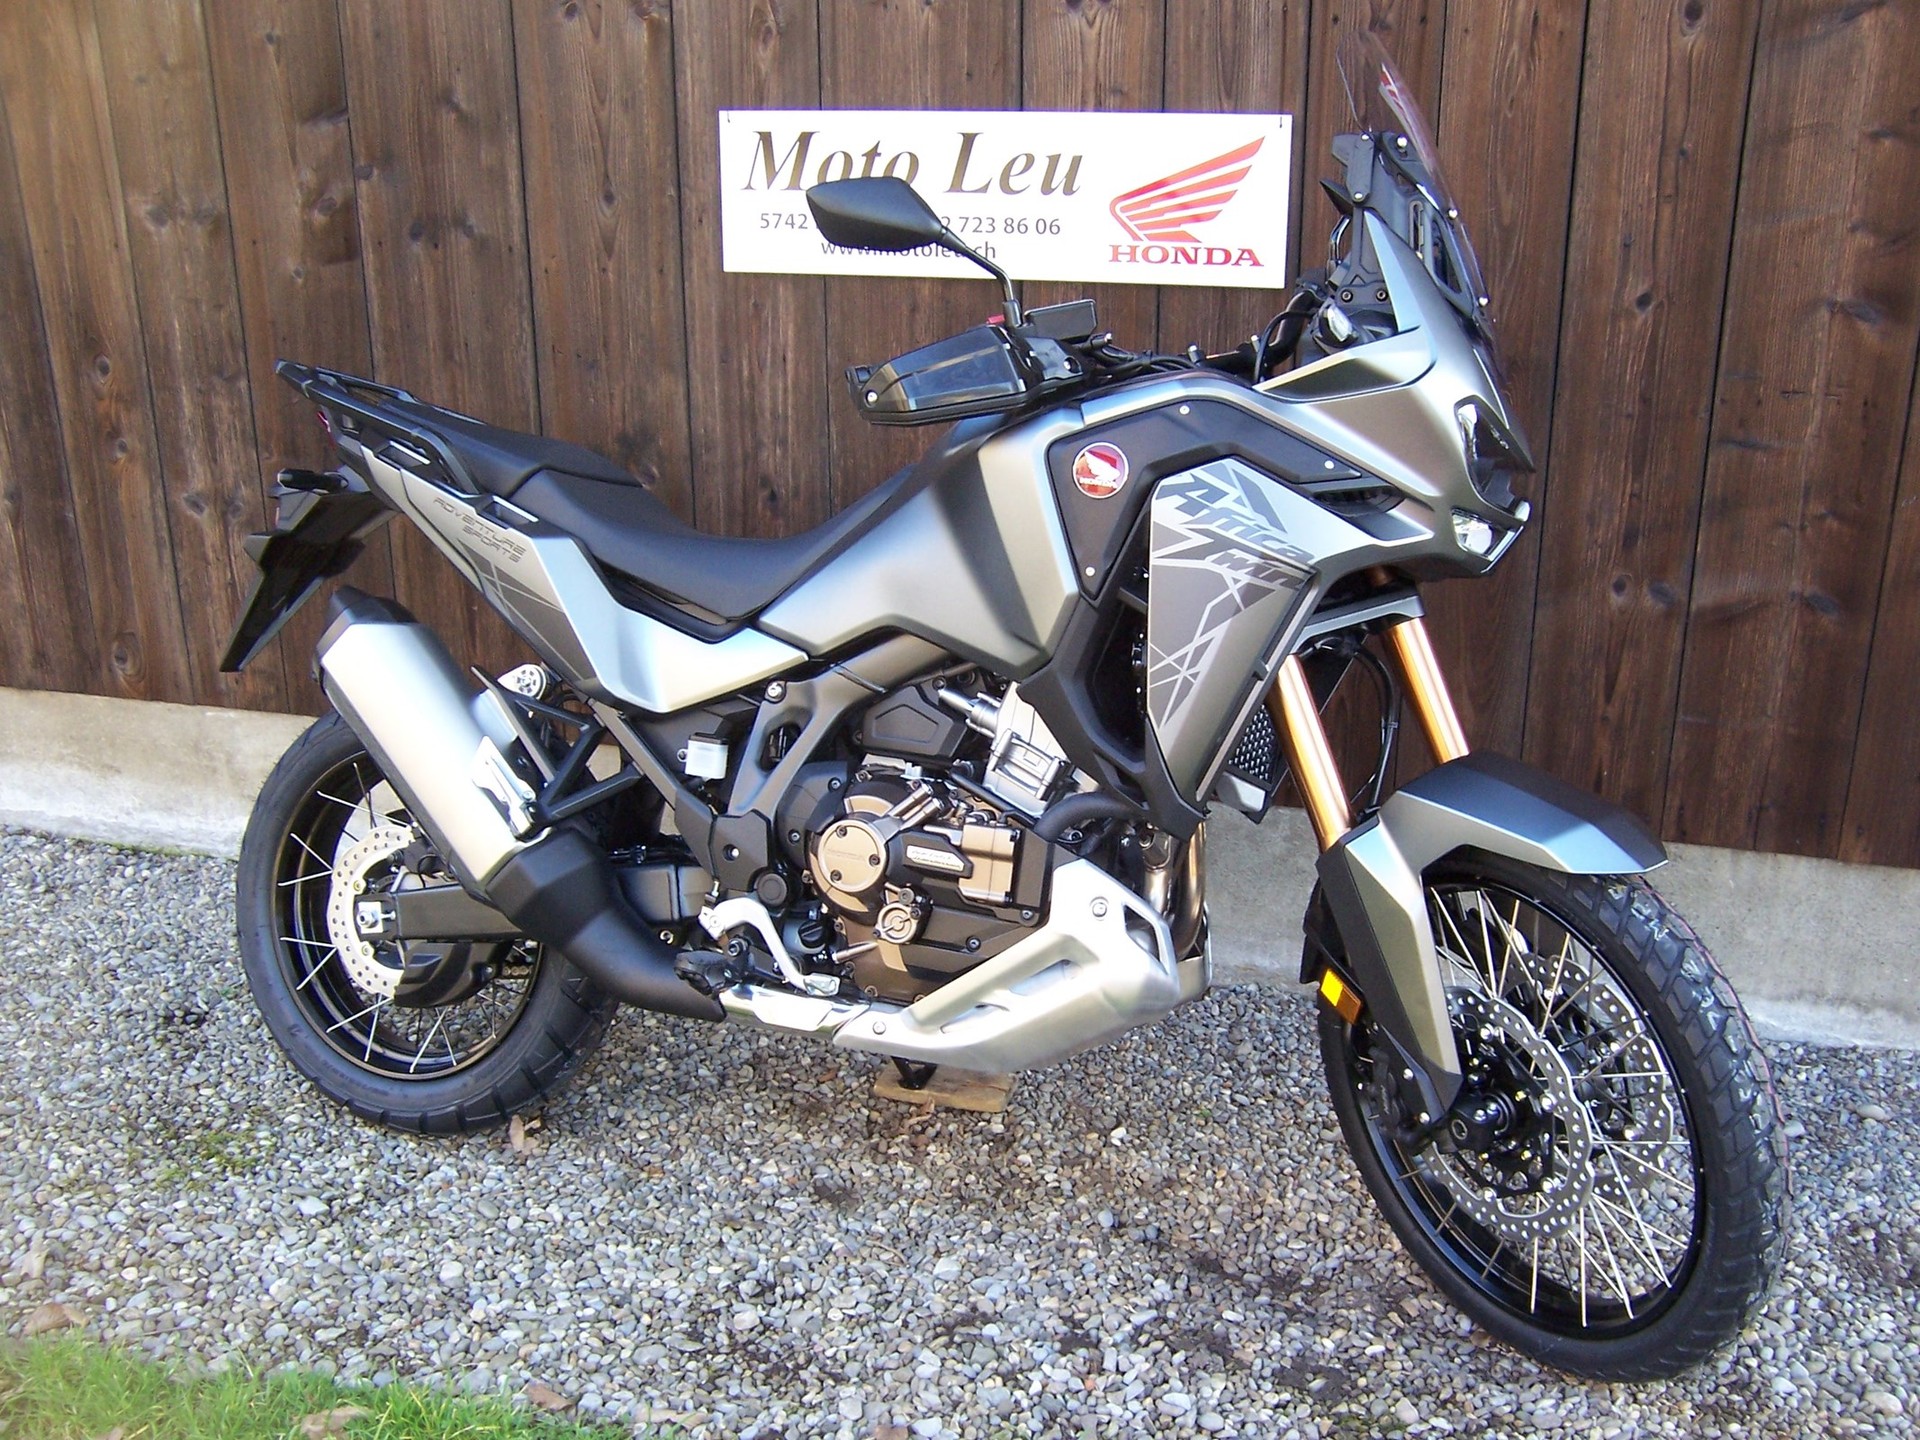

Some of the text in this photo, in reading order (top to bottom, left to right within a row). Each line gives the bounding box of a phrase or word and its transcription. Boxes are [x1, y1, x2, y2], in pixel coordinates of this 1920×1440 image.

[741, 131, 1083, 196] Moto Leu
[760, 213, 808, 230] 5742
[959, 216, 996, 233] 723
[1004, 217, 1029, 234] 86
[1036, 218, 1061, 235] 06
[1108, 244, 1265, 267] HONDA
[433, 497, 527, 556] ADVENTURE
[462, 525, 521, 563] SPORTS
